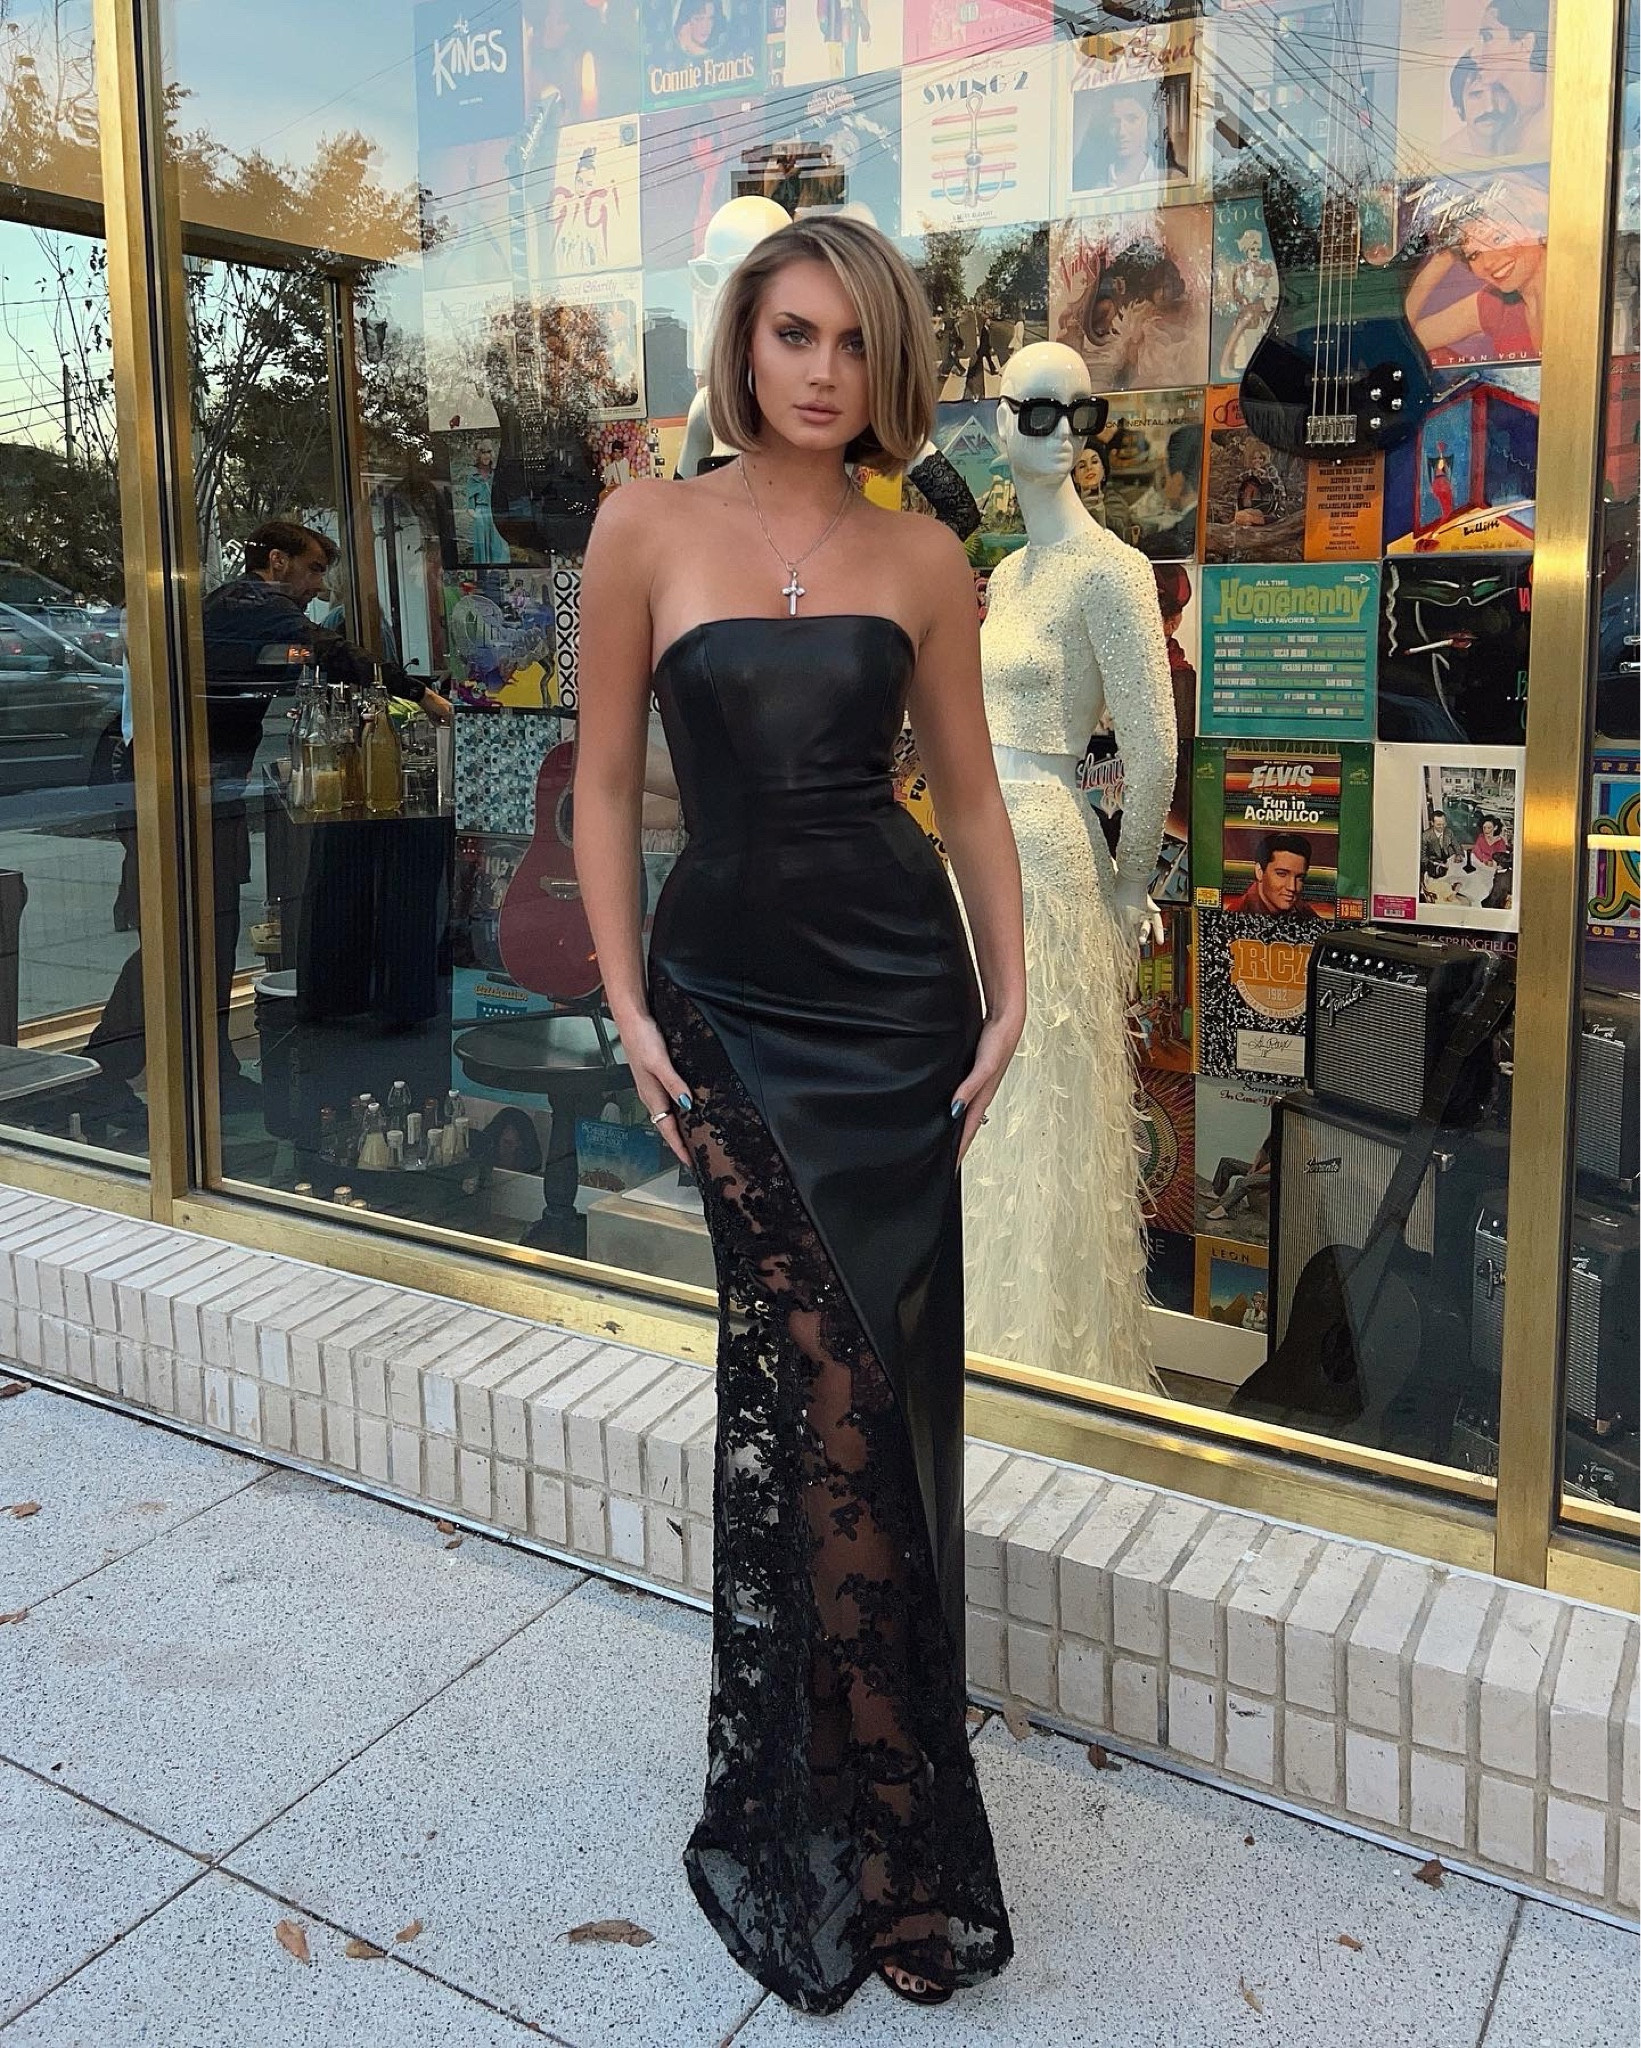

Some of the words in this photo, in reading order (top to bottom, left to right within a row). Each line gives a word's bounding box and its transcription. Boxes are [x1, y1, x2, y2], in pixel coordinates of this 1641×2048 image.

[432, 28, 508, 97] KINGS
[650, 63, 701, 95] Connie
[703, 53, 754, 85] Francis
[923, 74, 1007, 104] SWING
[1014, 71, 1029, 91] 2
[1448, 354, 1487, 363] THAN
[1498, 351, 1527, 360] YOU
[1212, 578, 1370, 624] Hootenanny
[1248, 765, 1314, 788] ELVIS
[1292, 796, 1305, 810] in
[1267, 987, 1287, 1001] 1982
[1243, 1081, 1279, 1095] Sonny
[1211, 1247, 1249, 1263] LEON
